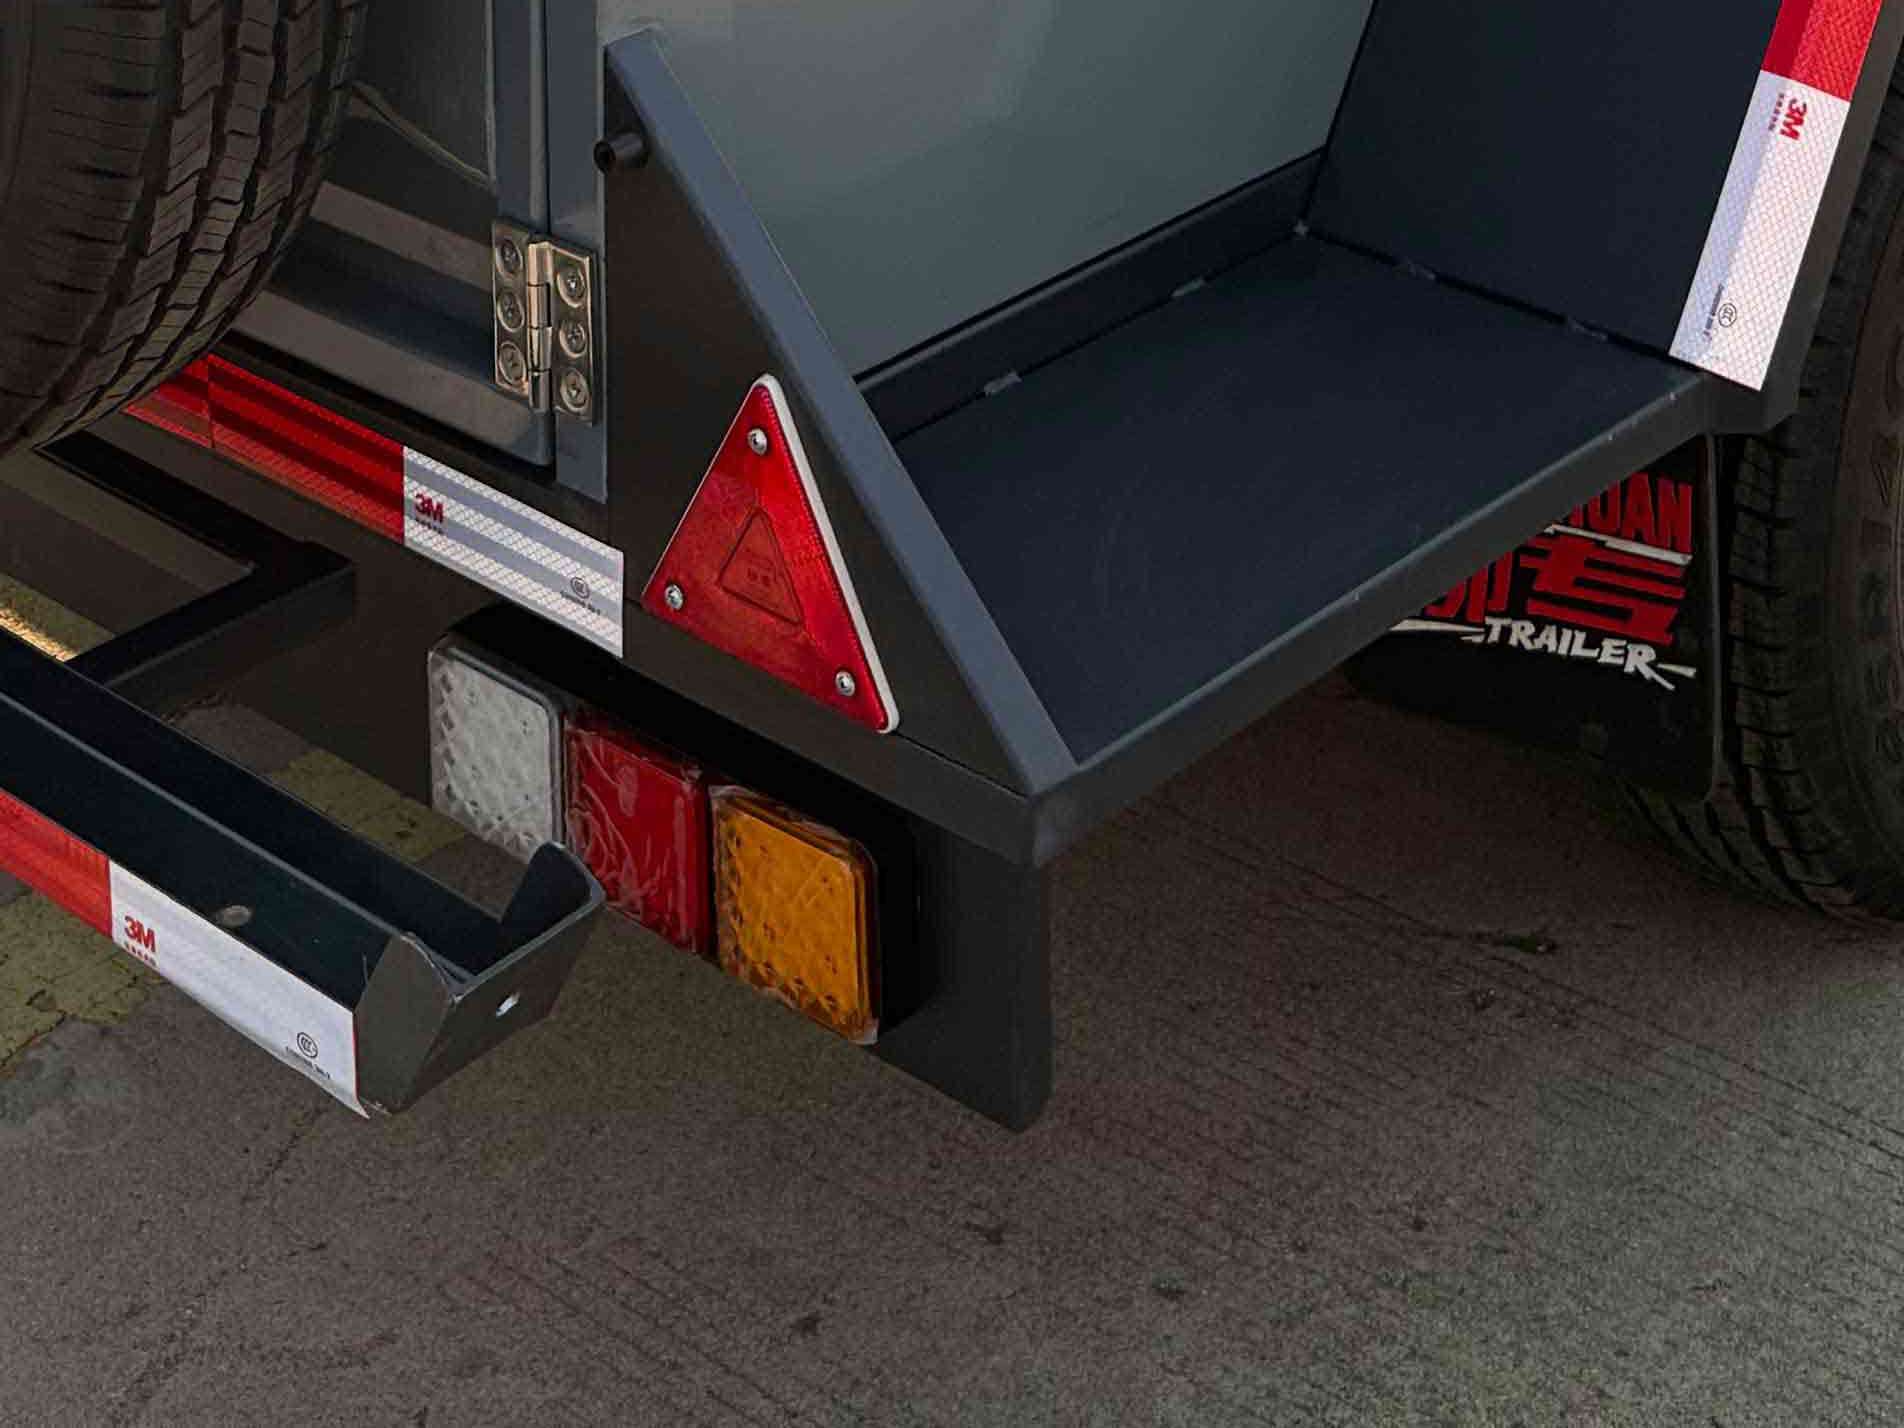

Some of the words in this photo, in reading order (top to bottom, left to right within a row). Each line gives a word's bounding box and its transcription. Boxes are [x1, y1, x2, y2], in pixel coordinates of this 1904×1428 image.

[1779, 97, 1809, 142] 3M
[413, 493, 445, 523] 3M
[1482, 616, 1677, 692] TRAILER
[124, 915, 157, 955] 3M
